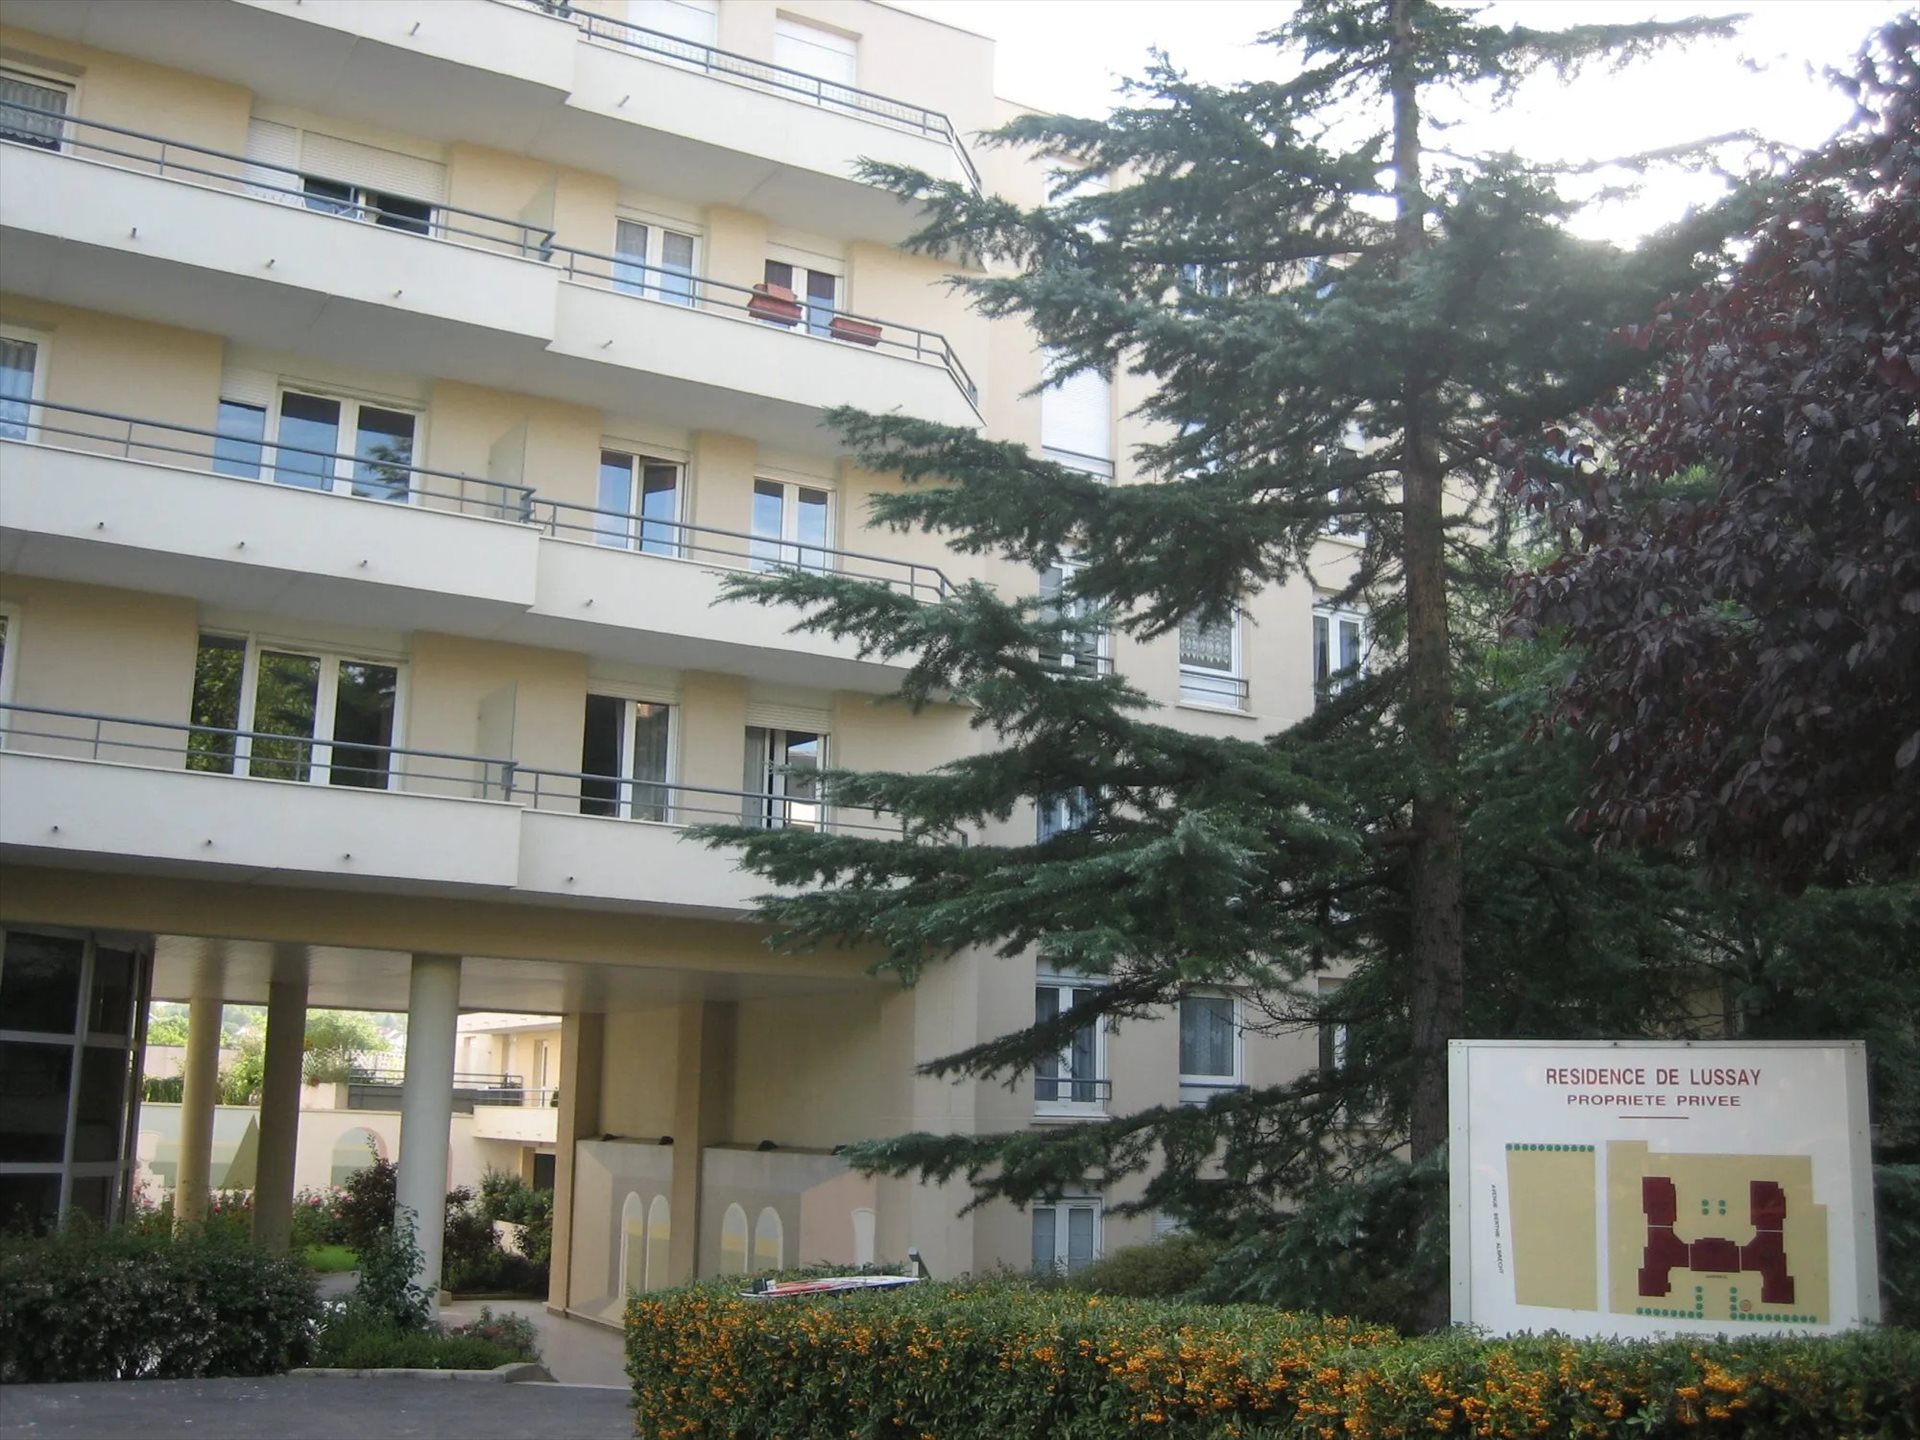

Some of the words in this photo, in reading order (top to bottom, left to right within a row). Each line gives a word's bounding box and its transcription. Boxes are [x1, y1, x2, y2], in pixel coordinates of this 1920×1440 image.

[1545, 1067, 1646, 1086] RESIDENCE
[1656, 1068, 1680, 1086] DE
[1690, 1068, 1762, 1087] LUSSAY
[1567, 1094, 1666, 1107] PROPRIETE
[1677, 1095, 1741, 1107] PRIVEE
